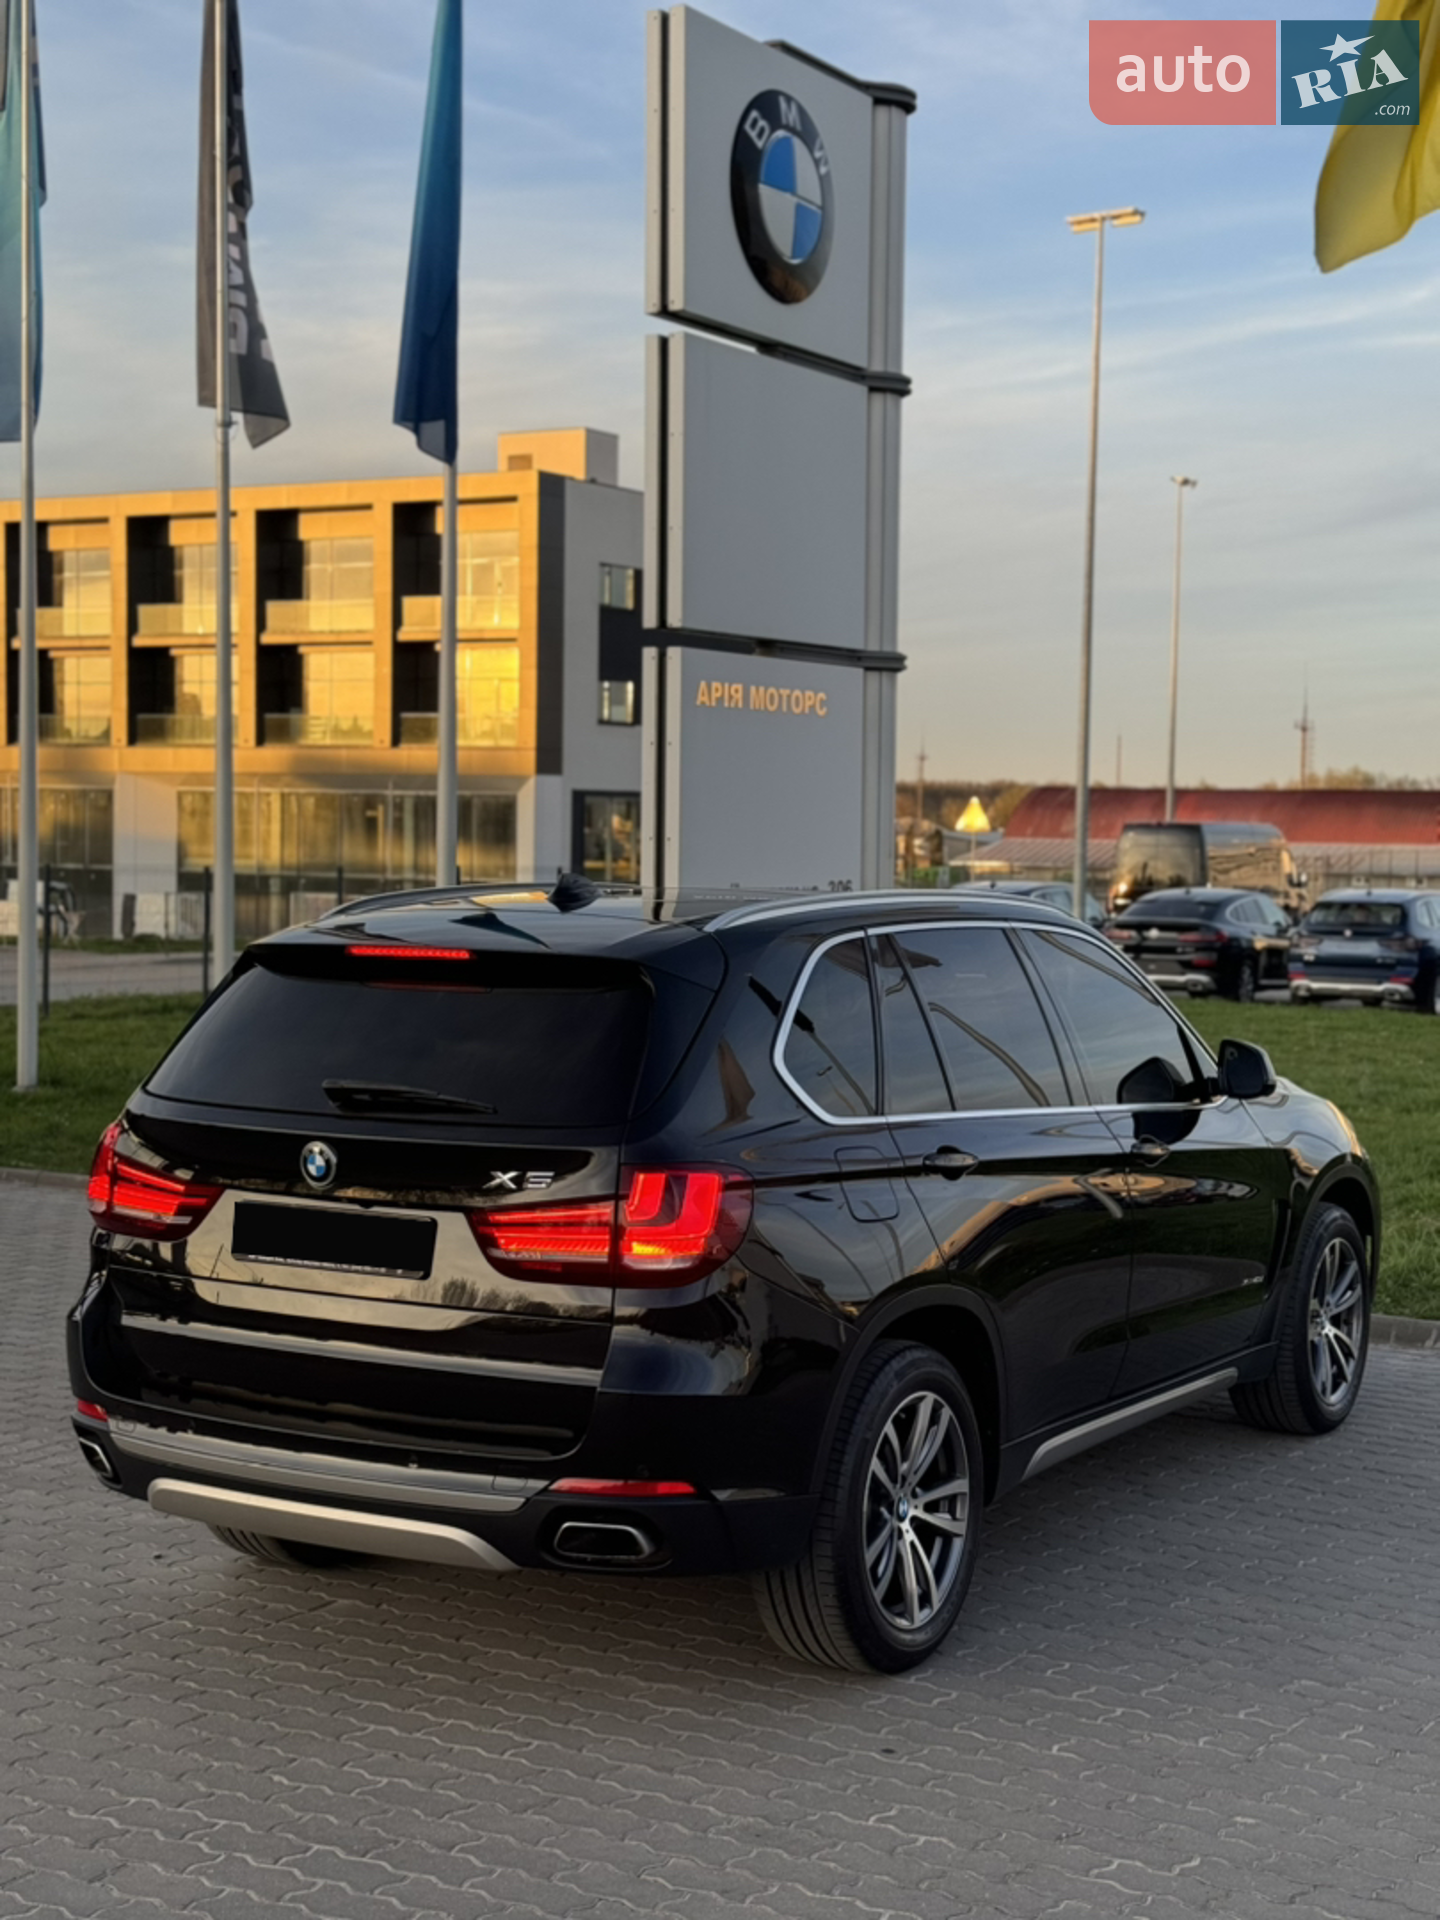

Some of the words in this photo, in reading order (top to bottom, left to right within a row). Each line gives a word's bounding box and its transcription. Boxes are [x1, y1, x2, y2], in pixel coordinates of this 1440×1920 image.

[743, 94, 830, 176] BMW
[696, 680, 743, 709] АРІЯ
[749, 684, 828, 717] МОТОРС
[482, 1170, 555, 1190] X5
